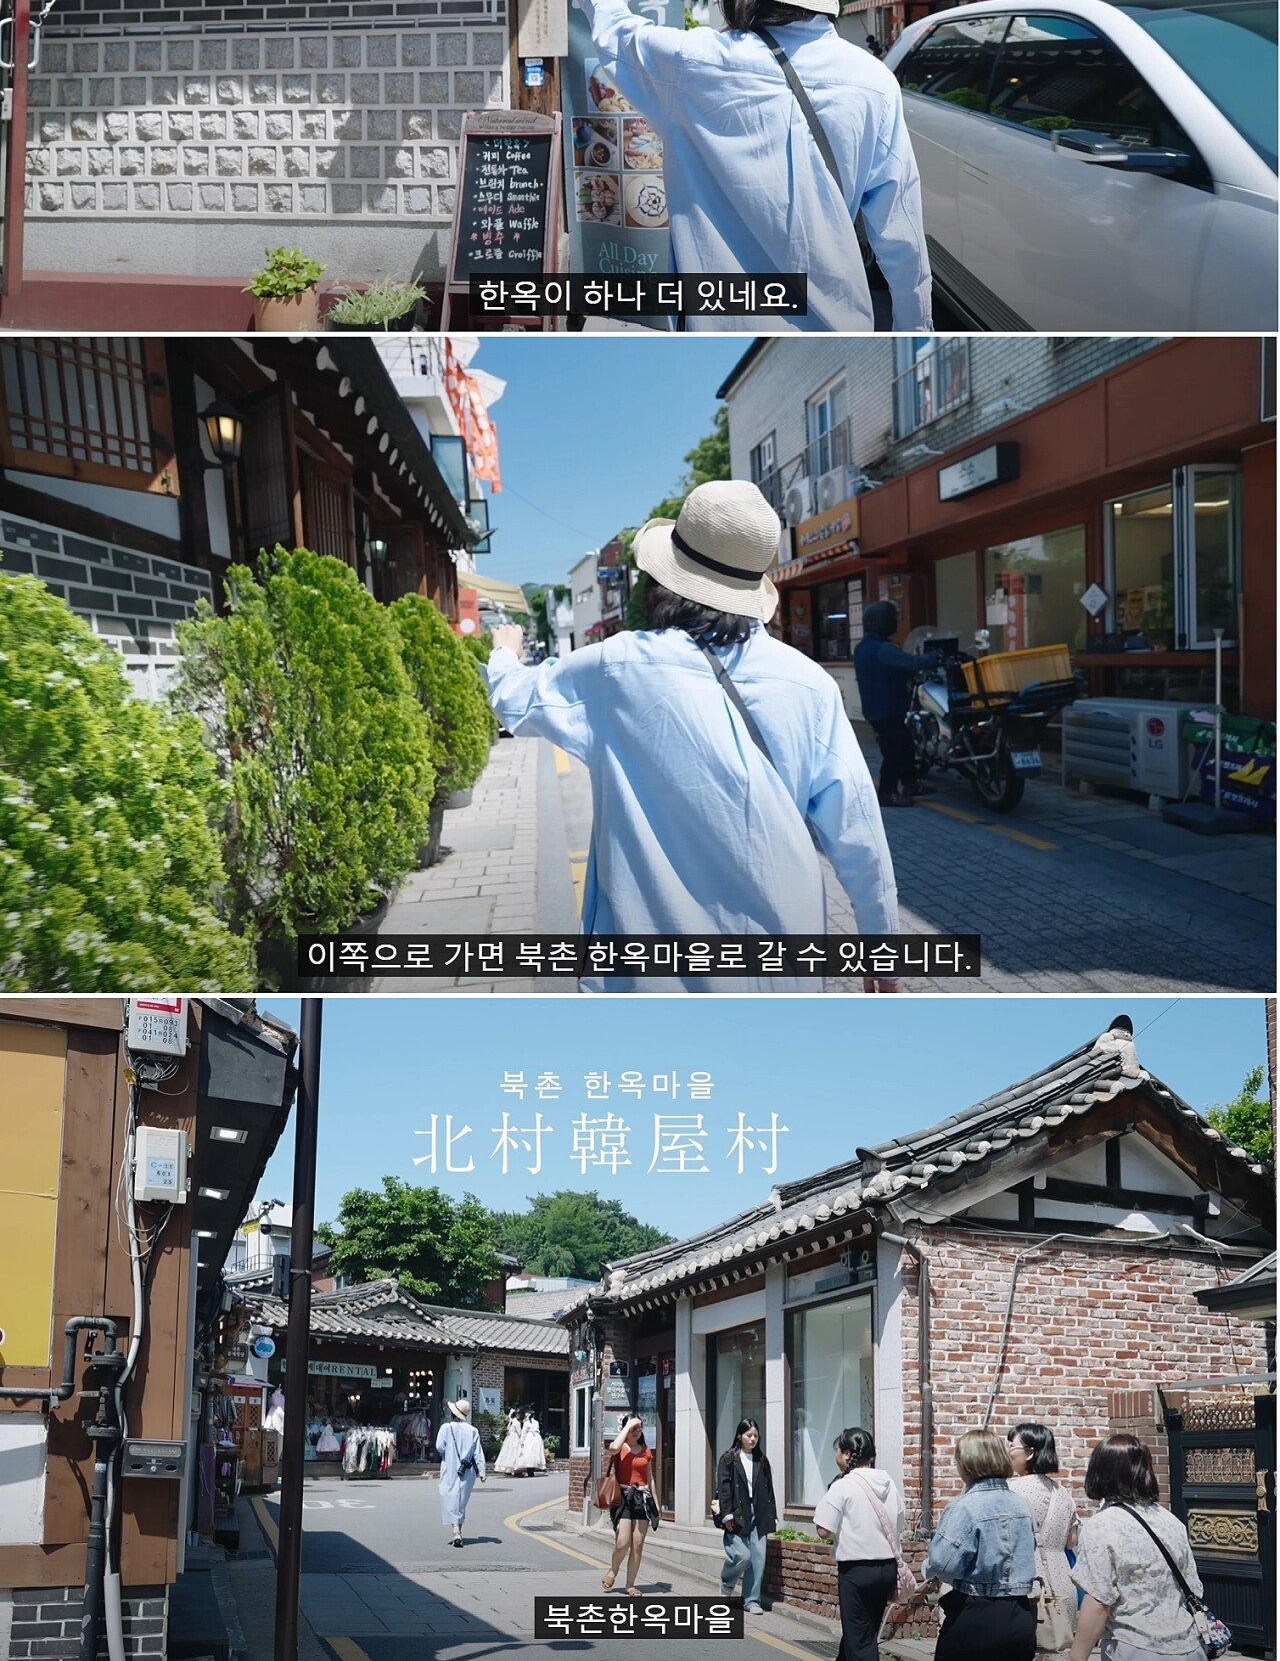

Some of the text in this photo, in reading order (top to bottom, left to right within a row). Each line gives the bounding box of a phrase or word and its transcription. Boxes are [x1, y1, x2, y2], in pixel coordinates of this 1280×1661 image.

[506, 150, 531, 161] Coffee
[511, 165, 529, 175] Tea
[477, 193, 503, 203] 스무디
[508, 205, 526, 214] Ade
[509, 218, 539, 230] Waffle
[482, 232, 505, 246] 빙수
[599, 242, 660, 267] All Day
[1148, 738, 1163, 750] LG
